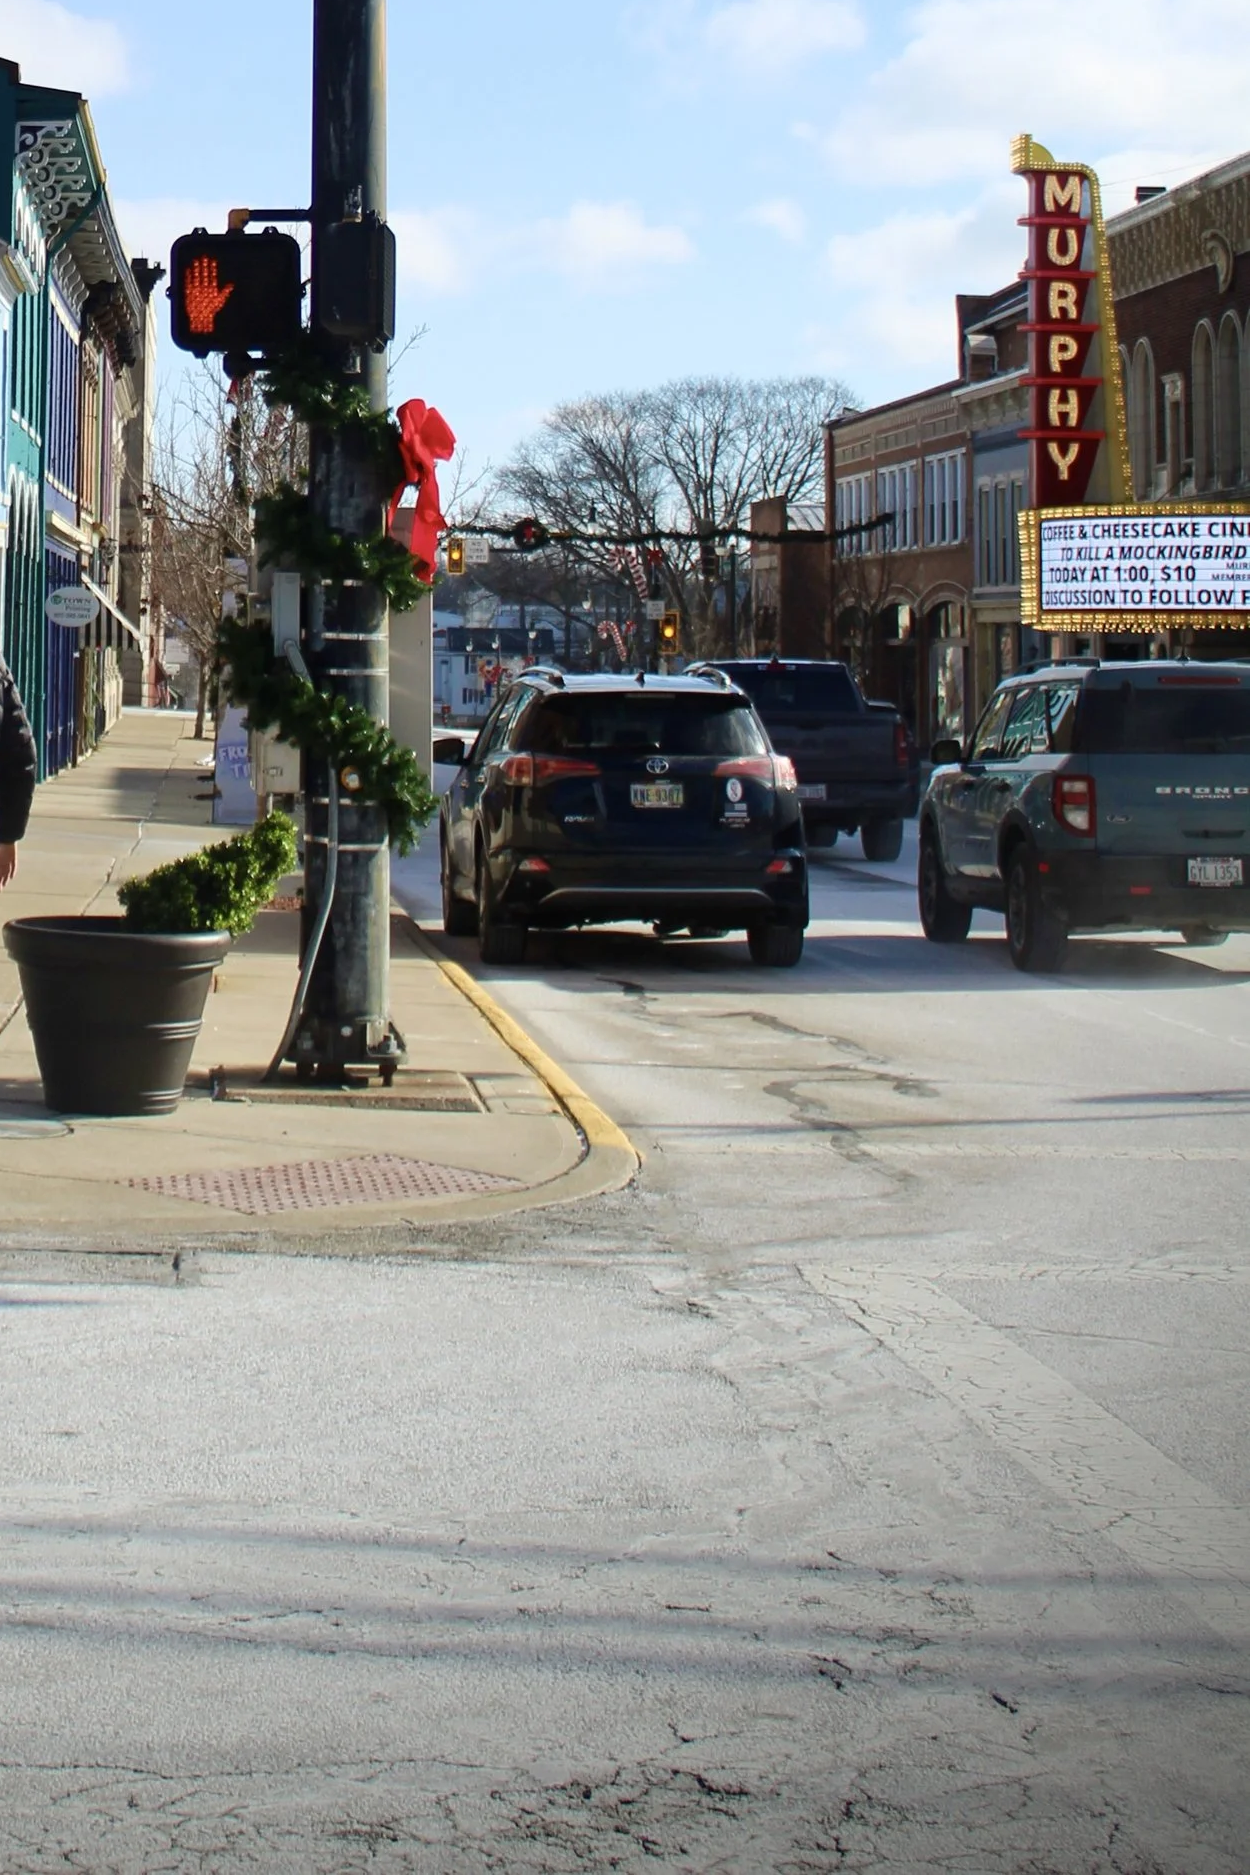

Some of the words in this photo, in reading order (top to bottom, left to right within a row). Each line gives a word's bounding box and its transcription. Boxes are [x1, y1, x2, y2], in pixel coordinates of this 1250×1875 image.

[1043, 174, 1082, 481] MURPHY
[1042, 526, 1075, 542] COFFEE
[1078, 525, 1088, 539] &
[1092, 522, 1201, 539] CHEESECAKE
[1061, 547, 1073, 562] TO
[1076, 546, 1101, 561] KILL
[1105, 546, 1115, 561] A
[1119, 545, 1247, 561] MOCKINGBIRD
[1049, 567, 1087, 583] TODAY
[1091, 566, 1109, 582] AT
[1114, 566, 1155, 584] 1:00,
[1160, 565, 1196, 584] $10
[1226, 562, 1250, 571] MUR
[1045, 589, 1116, 606] DISCUSSION
[1121, 589, 1143, 605] TO
[1149, 589, 1234, 605] FOLLOW
[218, 745, 248, 762] FRO
